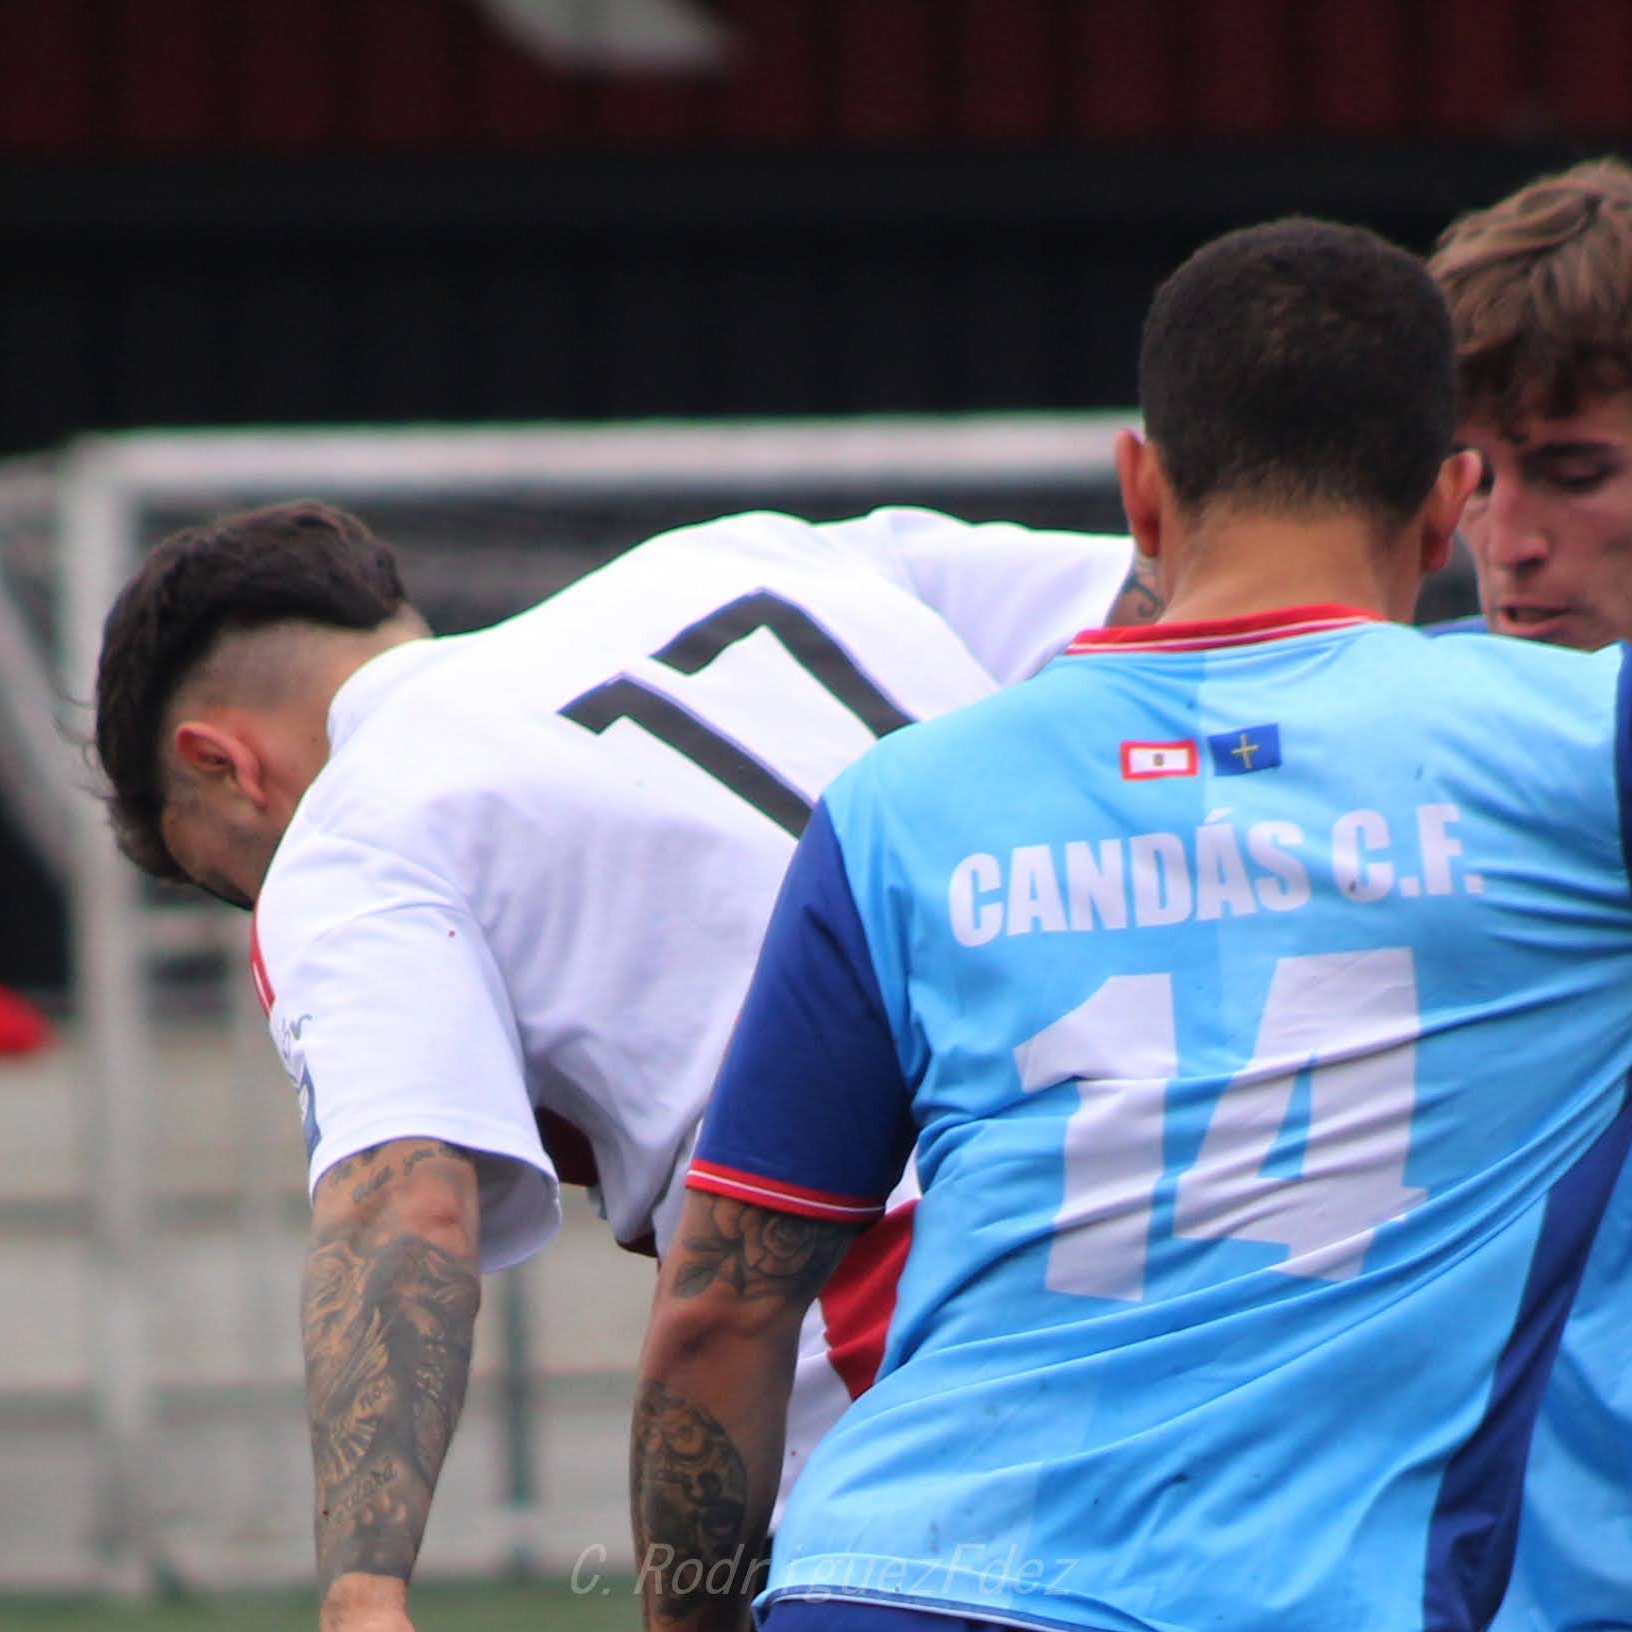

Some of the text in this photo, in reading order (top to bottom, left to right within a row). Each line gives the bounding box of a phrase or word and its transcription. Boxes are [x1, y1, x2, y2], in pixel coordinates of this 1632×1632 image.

[948, 802, 1485, 948] CANDÁS C.F.
[1012, 946, 1429, 1302] 14
